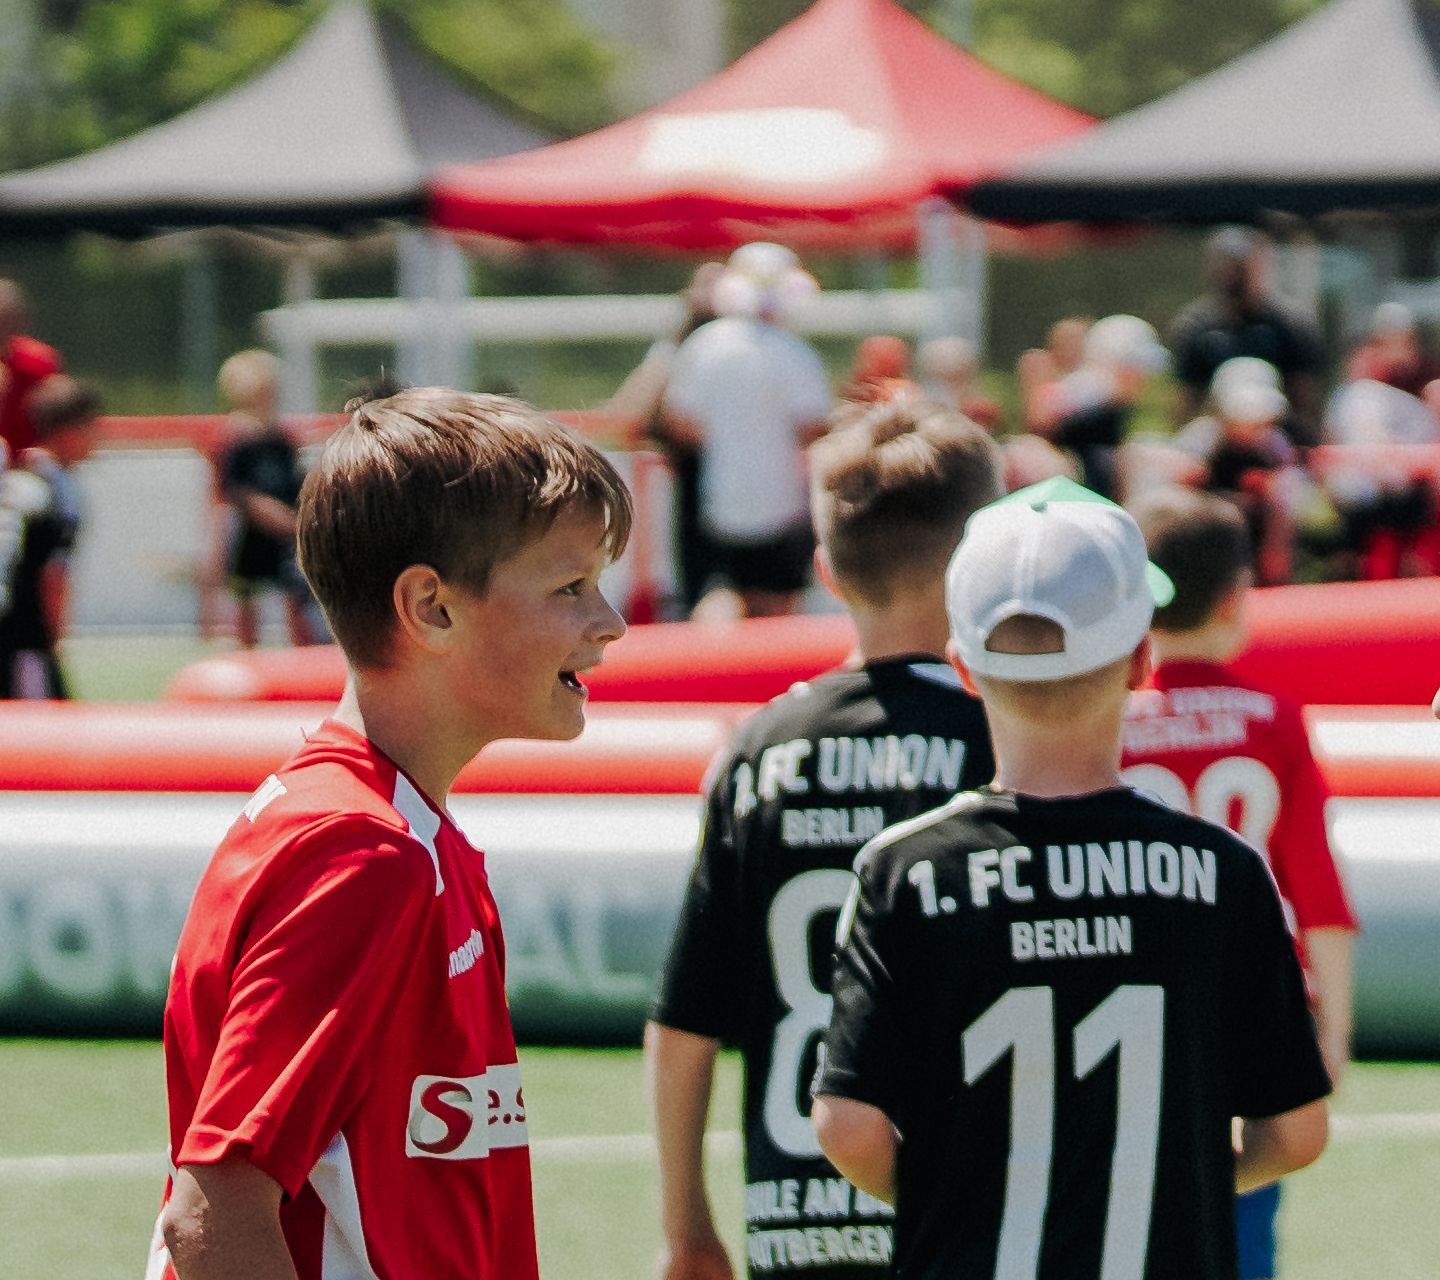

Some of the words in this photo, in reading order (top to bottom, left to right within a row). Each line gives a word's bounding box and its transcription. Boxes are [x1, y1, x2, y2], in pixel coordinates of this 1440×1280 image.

[758, 738, 813, 802] FC
[817, 733, 966, 792] UNION
[781, 806, 885, 848] BERLIN
[908, 859, 957, 918] 1.
[967, 845, 1035, 910] FC
[1047, 839, 1217, 906] UNION
[1011, 915, 1134, 962] BERLIN
